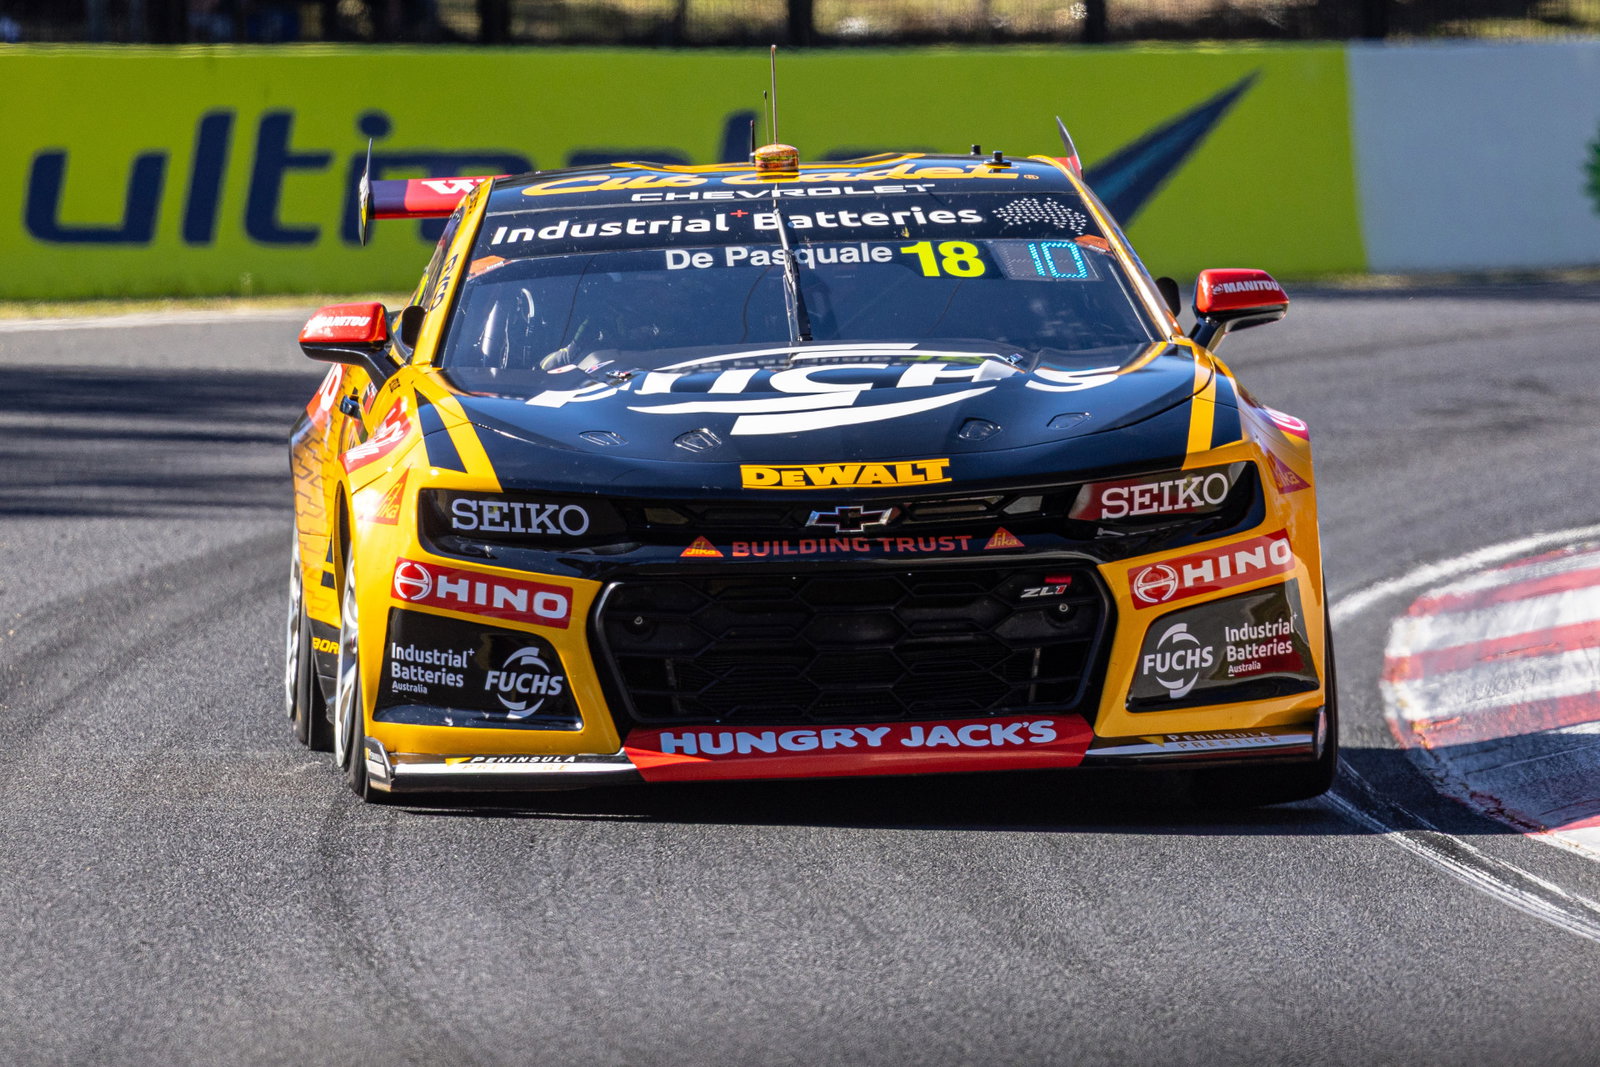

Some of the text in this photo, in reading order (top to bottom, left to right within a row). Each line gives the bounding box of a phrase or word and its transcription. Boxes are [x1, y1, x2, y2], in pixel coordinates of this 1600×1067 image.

[521, 163, 1019, 196] Cub Cadet
[631, 183, 936, 202] CHEVROLET
[491, 206, 984, 245] Industrial Batteries
[665, 242, 893, 270] De Pasquale
[900, 240, 986, 278] 18
[1223, 280, 1281, 294] MANITOU
[740, 458, 952, 490] DEWALT
[1101, 472, 1229, 520] SEIKO
[451, 498, 590, 536] SEIKO
[732, 537, 869, 557] BUILDING
[873, 535, 973, 553] TRUST
[988, 532, 1018, 547] Sika
[1182, 537, 1292, 588] HINO
[436, 574, 569, 620] HINO
[1020, 584, 1067, 598] ZL1
[1225, 618, 1295, 643] Industrial
[391, 642, 468, 669] Industrial
[1143, 645, 1214, 676] FUCHS
[1226, 639, 1293, 663] Batteries
[391, 661, 464, 688] Batteries
[1227, 660, 1261, 675] Australia
[391, 680, 428, 694] Australia
[484, 670, 564, 696] FUCHS
[660, 719, 1057, 755] HUNGRY JACK'S
[1167, 731, 1273, 742] PENINSULA
[1177, 737, 1281, 750] PRESTIGE
[469, 755, 576, 764] PENINSULA
